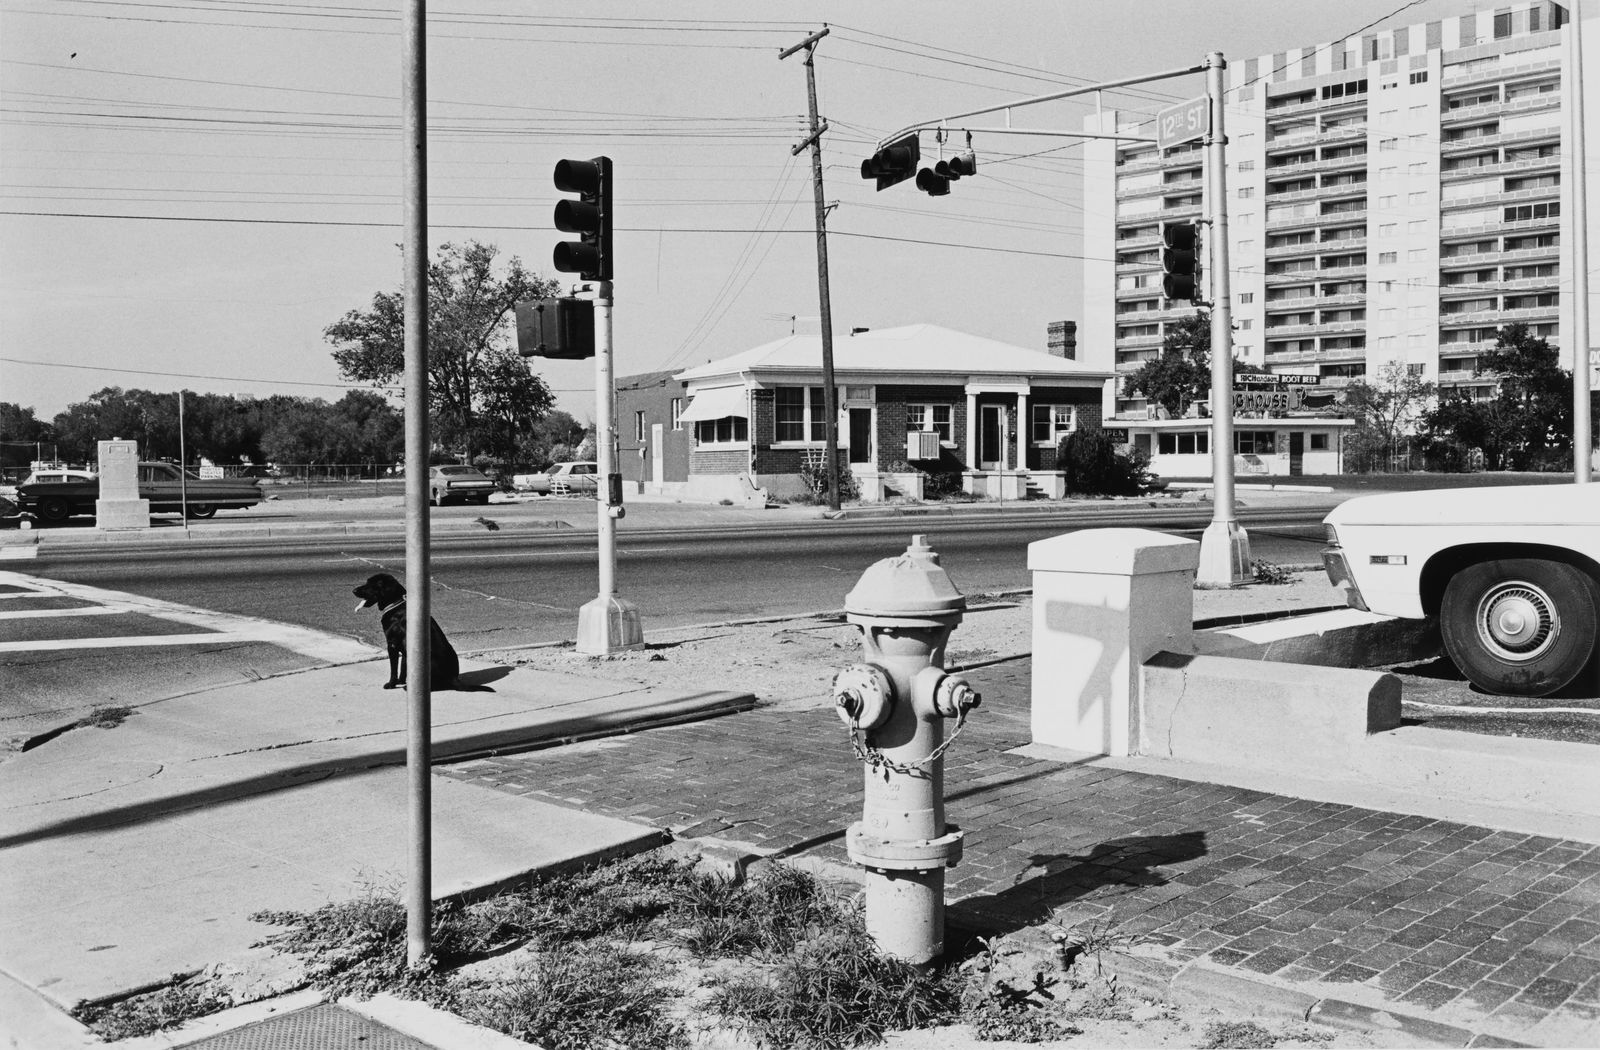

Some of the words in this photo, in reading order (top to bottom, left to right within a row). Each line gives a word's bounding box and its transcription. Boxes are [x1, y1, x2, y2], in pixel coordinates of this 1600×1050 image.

[1162, 111, 1184, 140] 12TH
[1187, 105, 1204, 131] ST
[1282, 375, 1301, 383] ROOT
[1302, 376, 1317, 384] BEER
[1247, 394, 1288, 408] HOUSE
